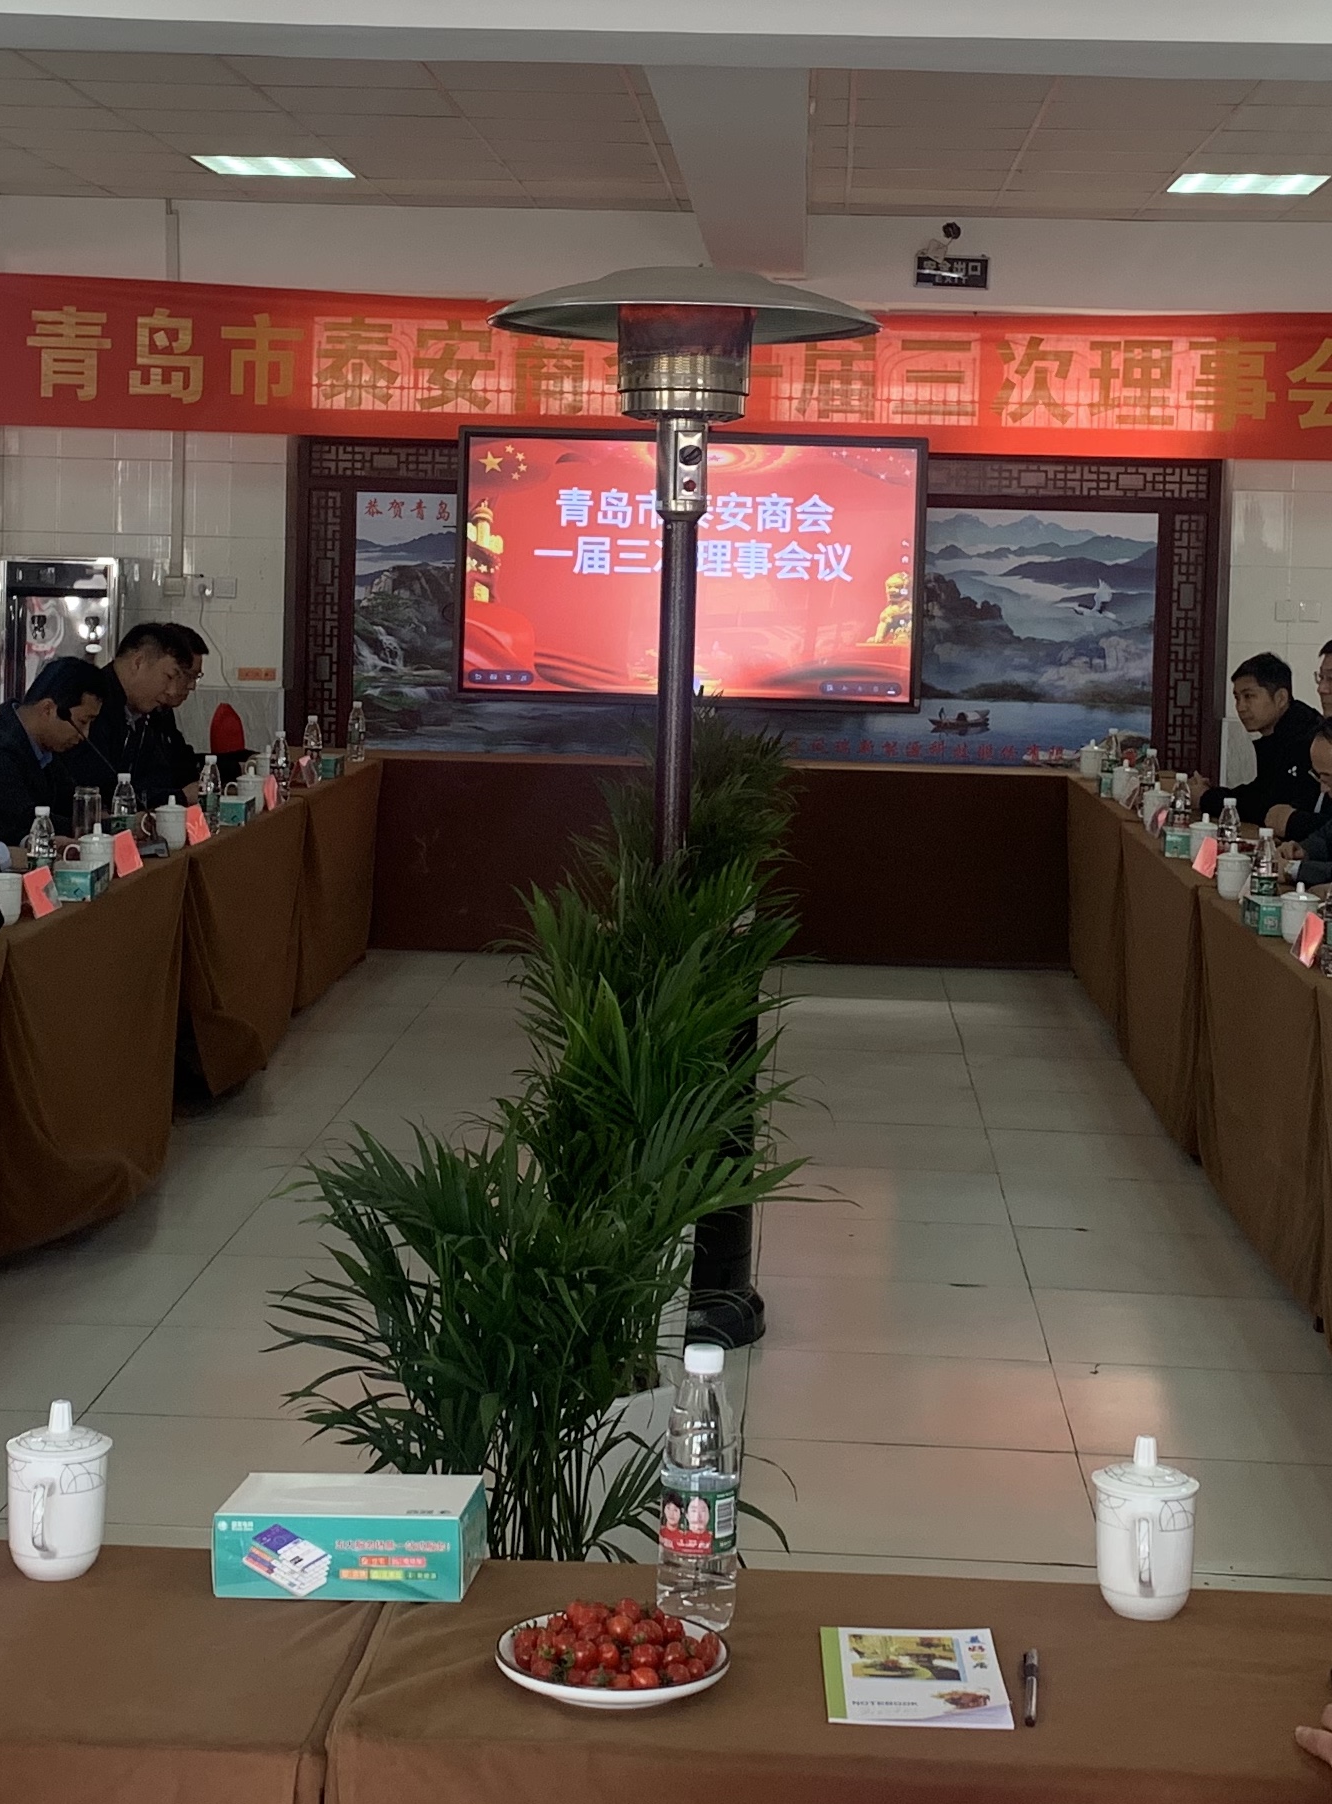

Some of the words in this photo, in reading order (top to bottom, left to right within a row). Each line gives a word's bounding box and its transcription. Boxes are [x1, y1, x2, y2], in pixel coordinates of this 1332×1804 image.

[364, 497, 451, 522] 恭贺青岛
[534, 536, 853, 583] 一届三理事会议
